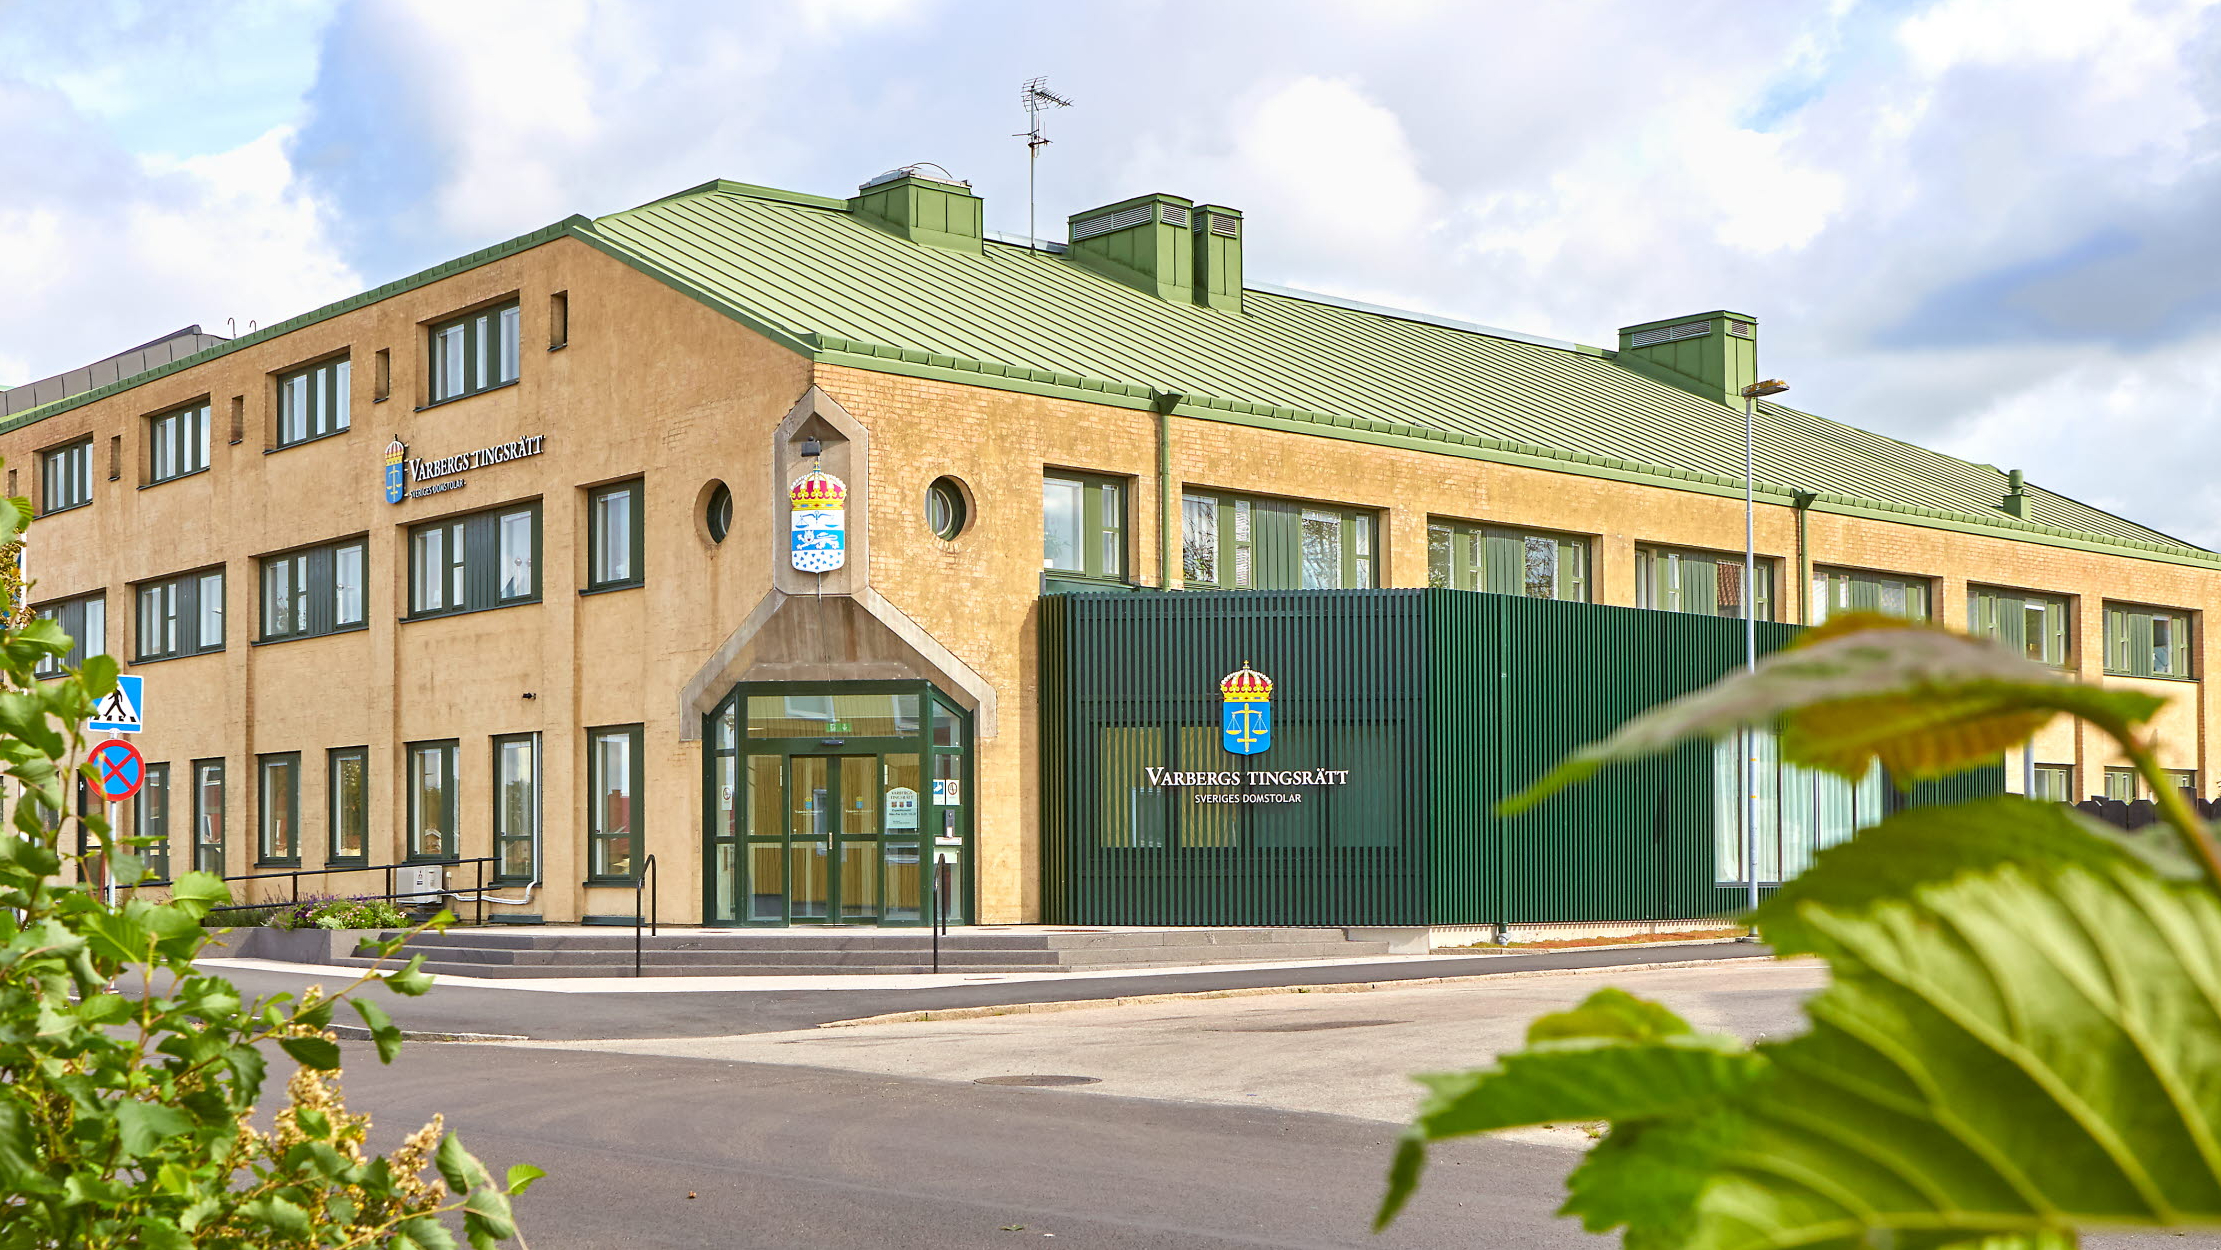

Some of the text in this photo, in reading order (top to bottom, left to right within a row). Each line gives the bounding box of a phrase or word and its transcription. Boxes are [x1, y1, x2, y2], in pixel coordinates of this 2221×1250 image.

[409, 435, 544, 482] VARBERGS TINGSRÄTT
[409, 479, 464, 499] SVERIGES DOMSTOLAR
[1145, 767, 1349, 786] VARBERGS TINGSRÄTT
[1195, 794, 1302, 804] SVERIGES DOMSTOLAR
